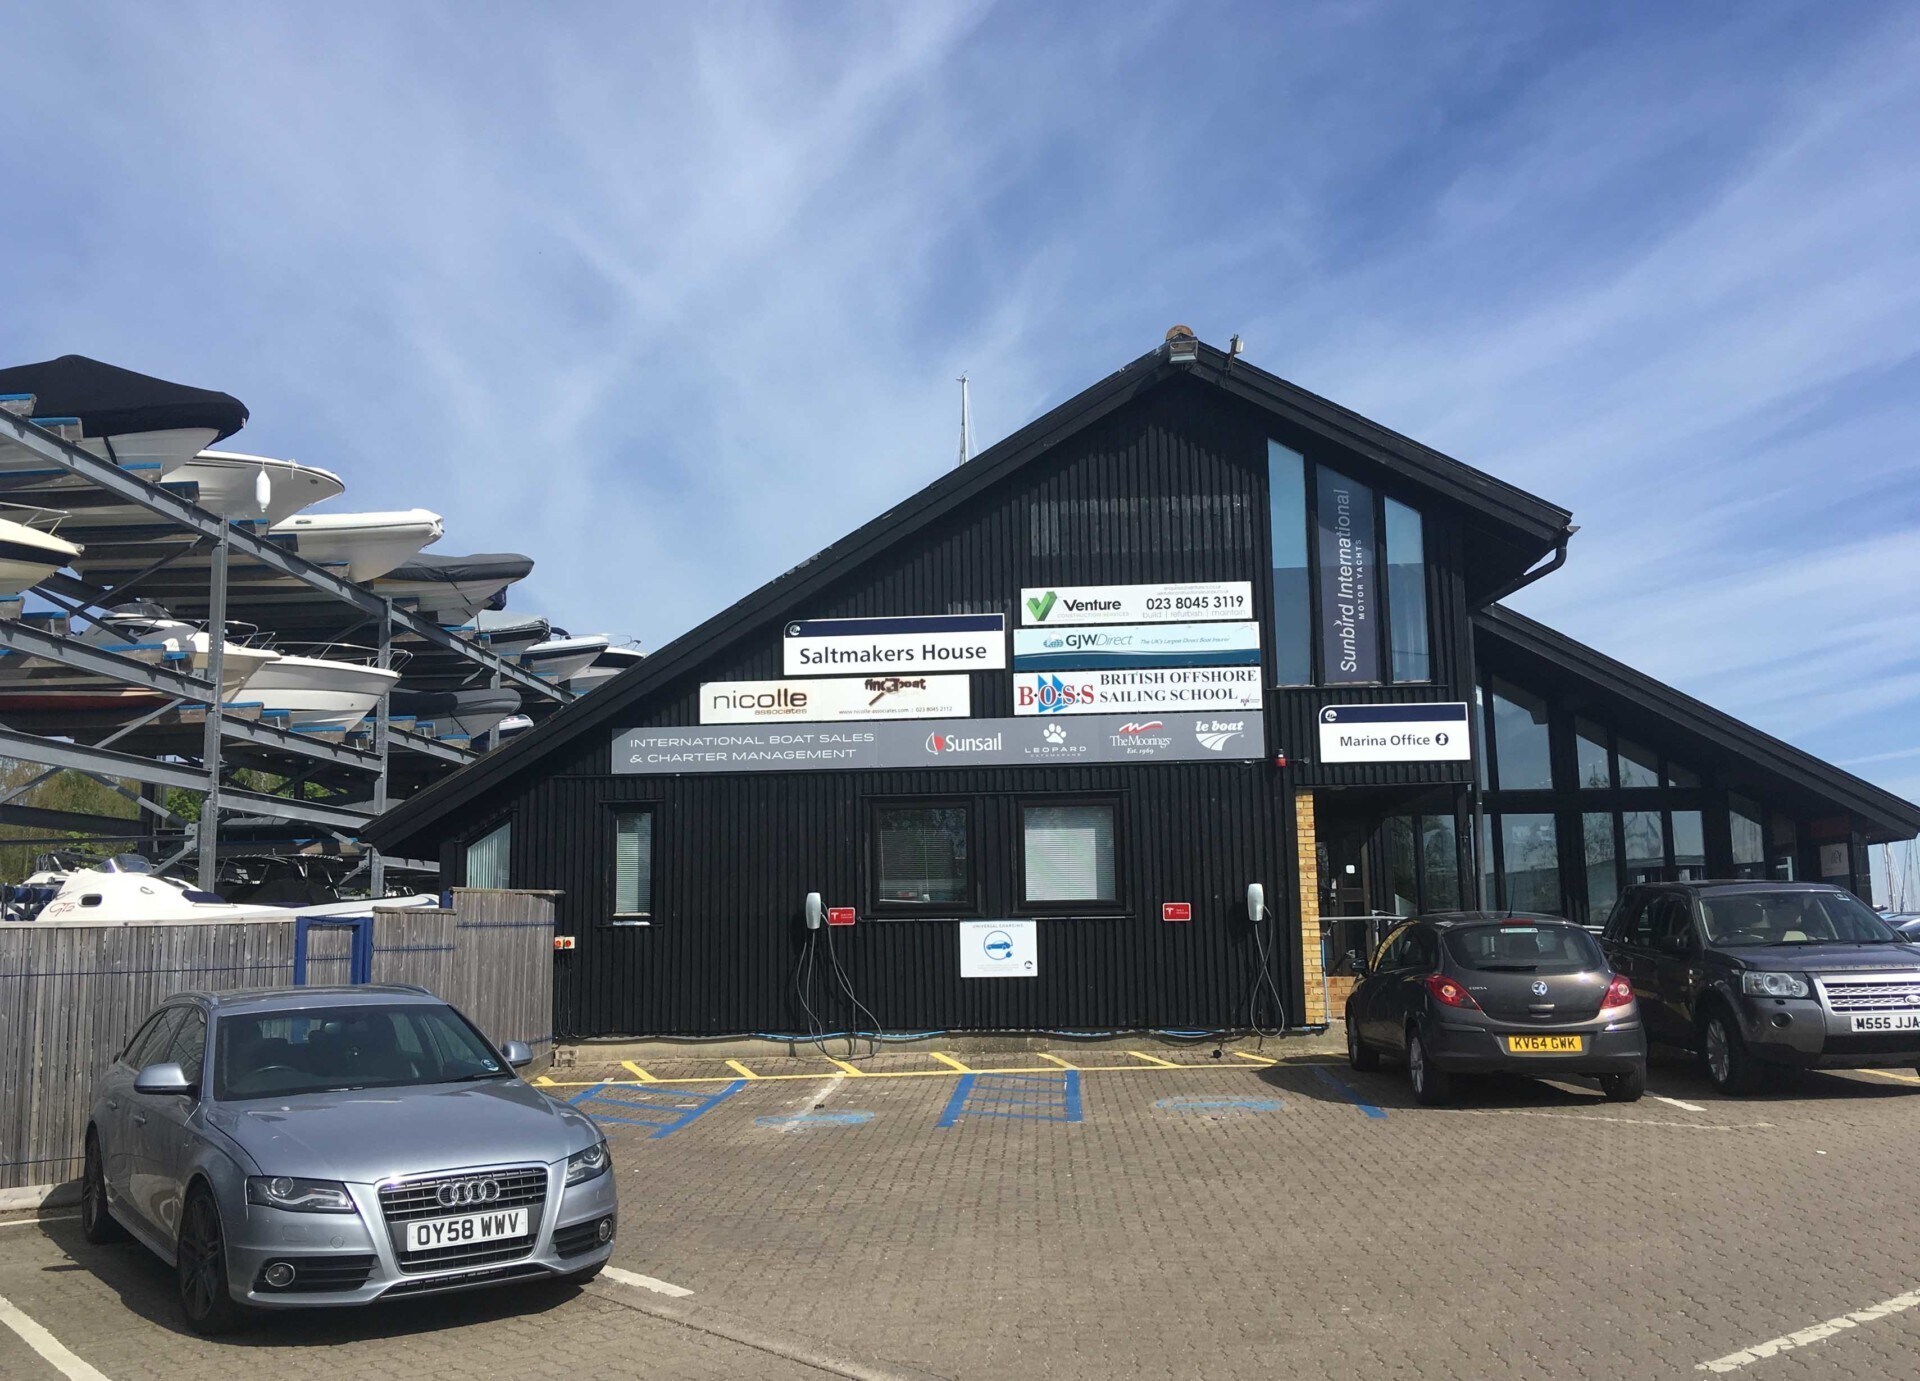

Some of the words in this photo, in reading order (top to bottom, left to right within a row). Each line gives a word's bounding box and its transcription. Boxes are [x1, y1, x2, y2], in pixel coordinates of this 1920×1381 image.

[1333, 489, 1354, 599] International
[1355, 539, 1363, 579] YACHTS
[1063, 599, 1122, 612] Venture
[1146, 598, 1172, 610] 023
[1175, 597, 1209, 609] 8045
[1213, 595, 1244, 608] 3119
[1357, 584, 1365, 620] MOTOR
[1142, 611, 1162, 619] build
[1170, 610, 1203, 618] refurbish
[1211, 608, 1246, 616] maintain
[1333, 602, 1356, 673] Sunbird
[799, 645, 915, 665] Saltmakers
[922, 644, 987, 661] House
[1100, 672, 1165, 685] BRITISH
[1170, 670, 1257, 684] OFFSHORE
[713, 688, 807, 709] nicolle
[1100, 691, 1166, 703] SAILING
[1170, 688, 1238, 701] SCHOOL
[1195, 721, 1209, 732] le
[1211, 720, 1244, 731] boat
[630, 737, 764, 748] INTERNATIONAL
[769, 734, 815, 744] BOAT
[819, 733, 874, 743] SALES
[945, 732, 1002, 752] Sunsail
[1110, 735, 1128, 746] The
[1128, 734, 1170, 749] Moorings
[1340, 736, 1387, 747] Marina
[1390, 735, 1431, 746] Office
[630, 754, 643, 763] &
[647, 751, 728, 763] CHARTER
[732, 749, 857, 761] MANAGEMENT
[1856, 1017, 1891, 1029] M555
[1895, 1016, 1919, 1028] JJA
[1515, 1037, 1547, 1049] KV64
[1552, 1038, 1576, 1048] GWK
[417, 1219, 474, 1246] OY58
[481, 1213, 519, 1237] WWV
